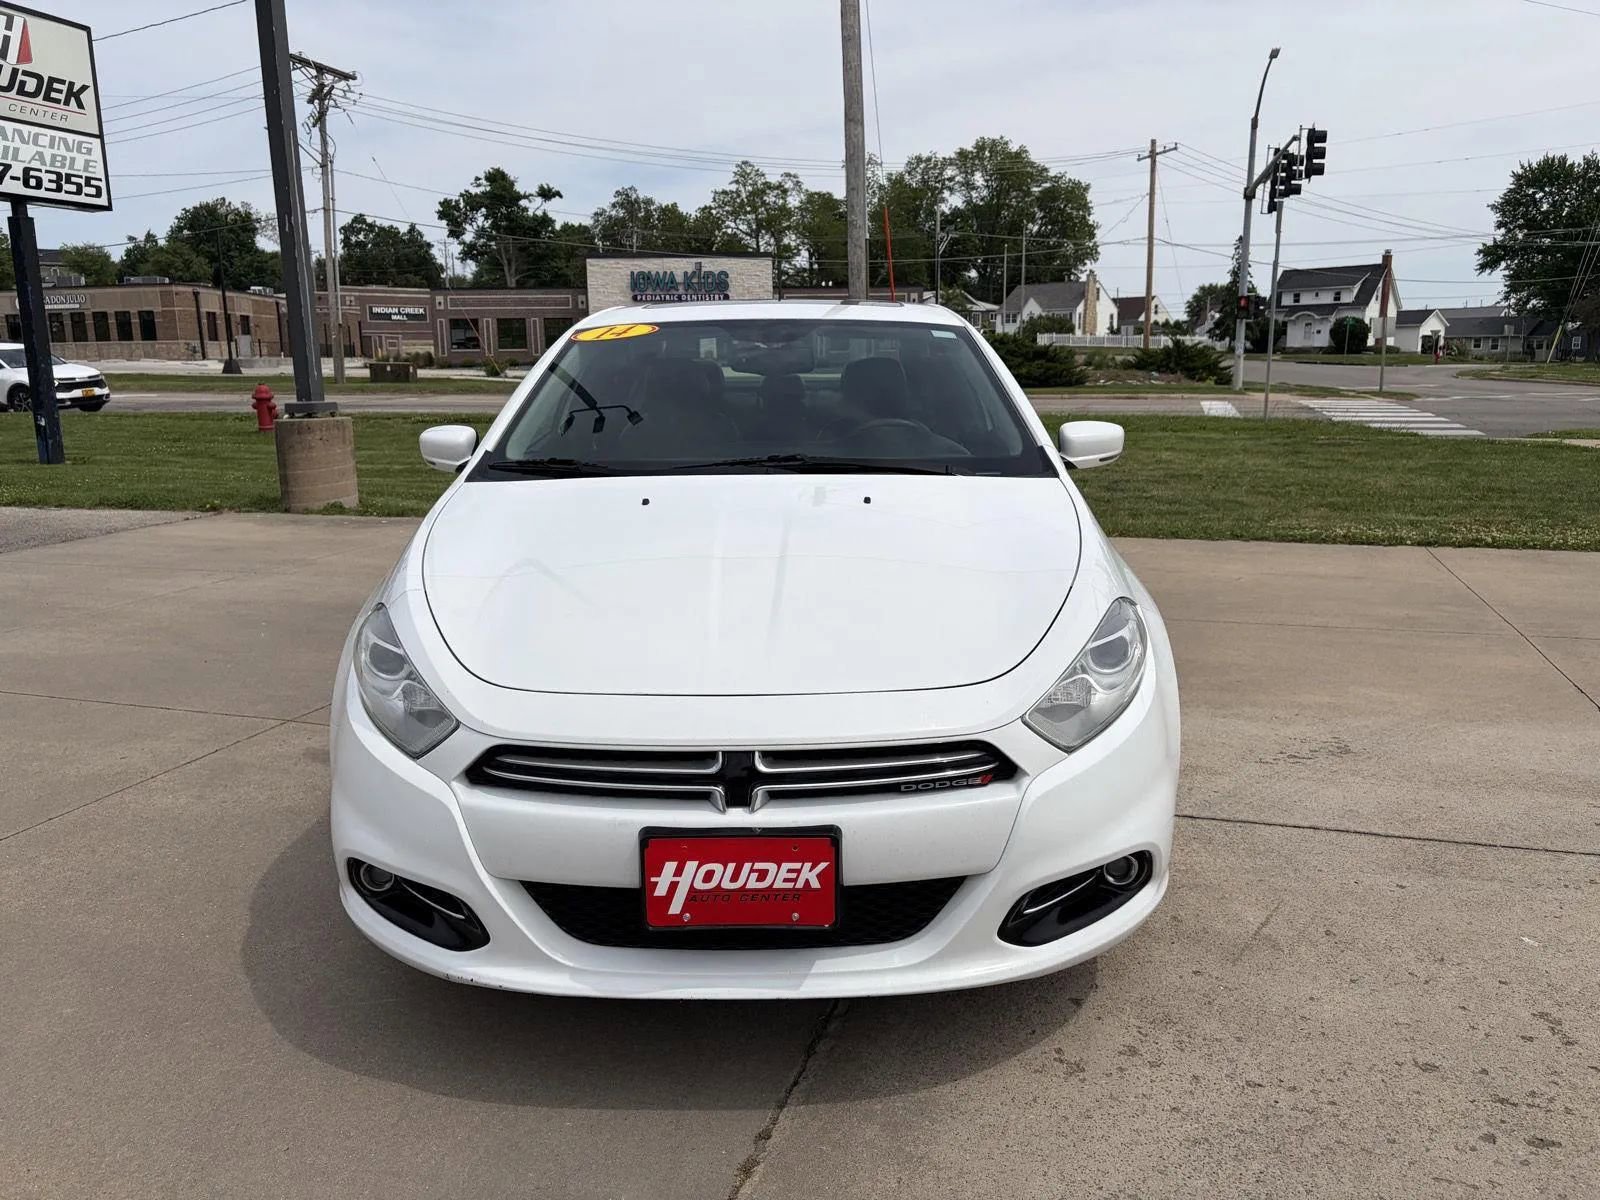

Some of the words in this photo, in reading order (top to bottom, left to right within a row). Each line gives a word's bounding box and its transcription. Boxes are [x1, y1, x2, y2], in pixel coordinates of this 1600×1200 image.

[8, 102, 69, 123] CENTER
[630, 270, 679, 292] IOWA
[683, 269, 730, 292] KIDS
[51, 295, 66, 304] DON
[66, 294, 86, 304] JULIO
[372, 306, 398, 314] INDIAN
[400, 307, 425, 315] CREEK
[900, 778, 982, 792] DODGE
[650, 860, 831, 915] HOUDEK
[689, 893, 731, 903] AUTO
[739, 893, 801, 902] CENTER
